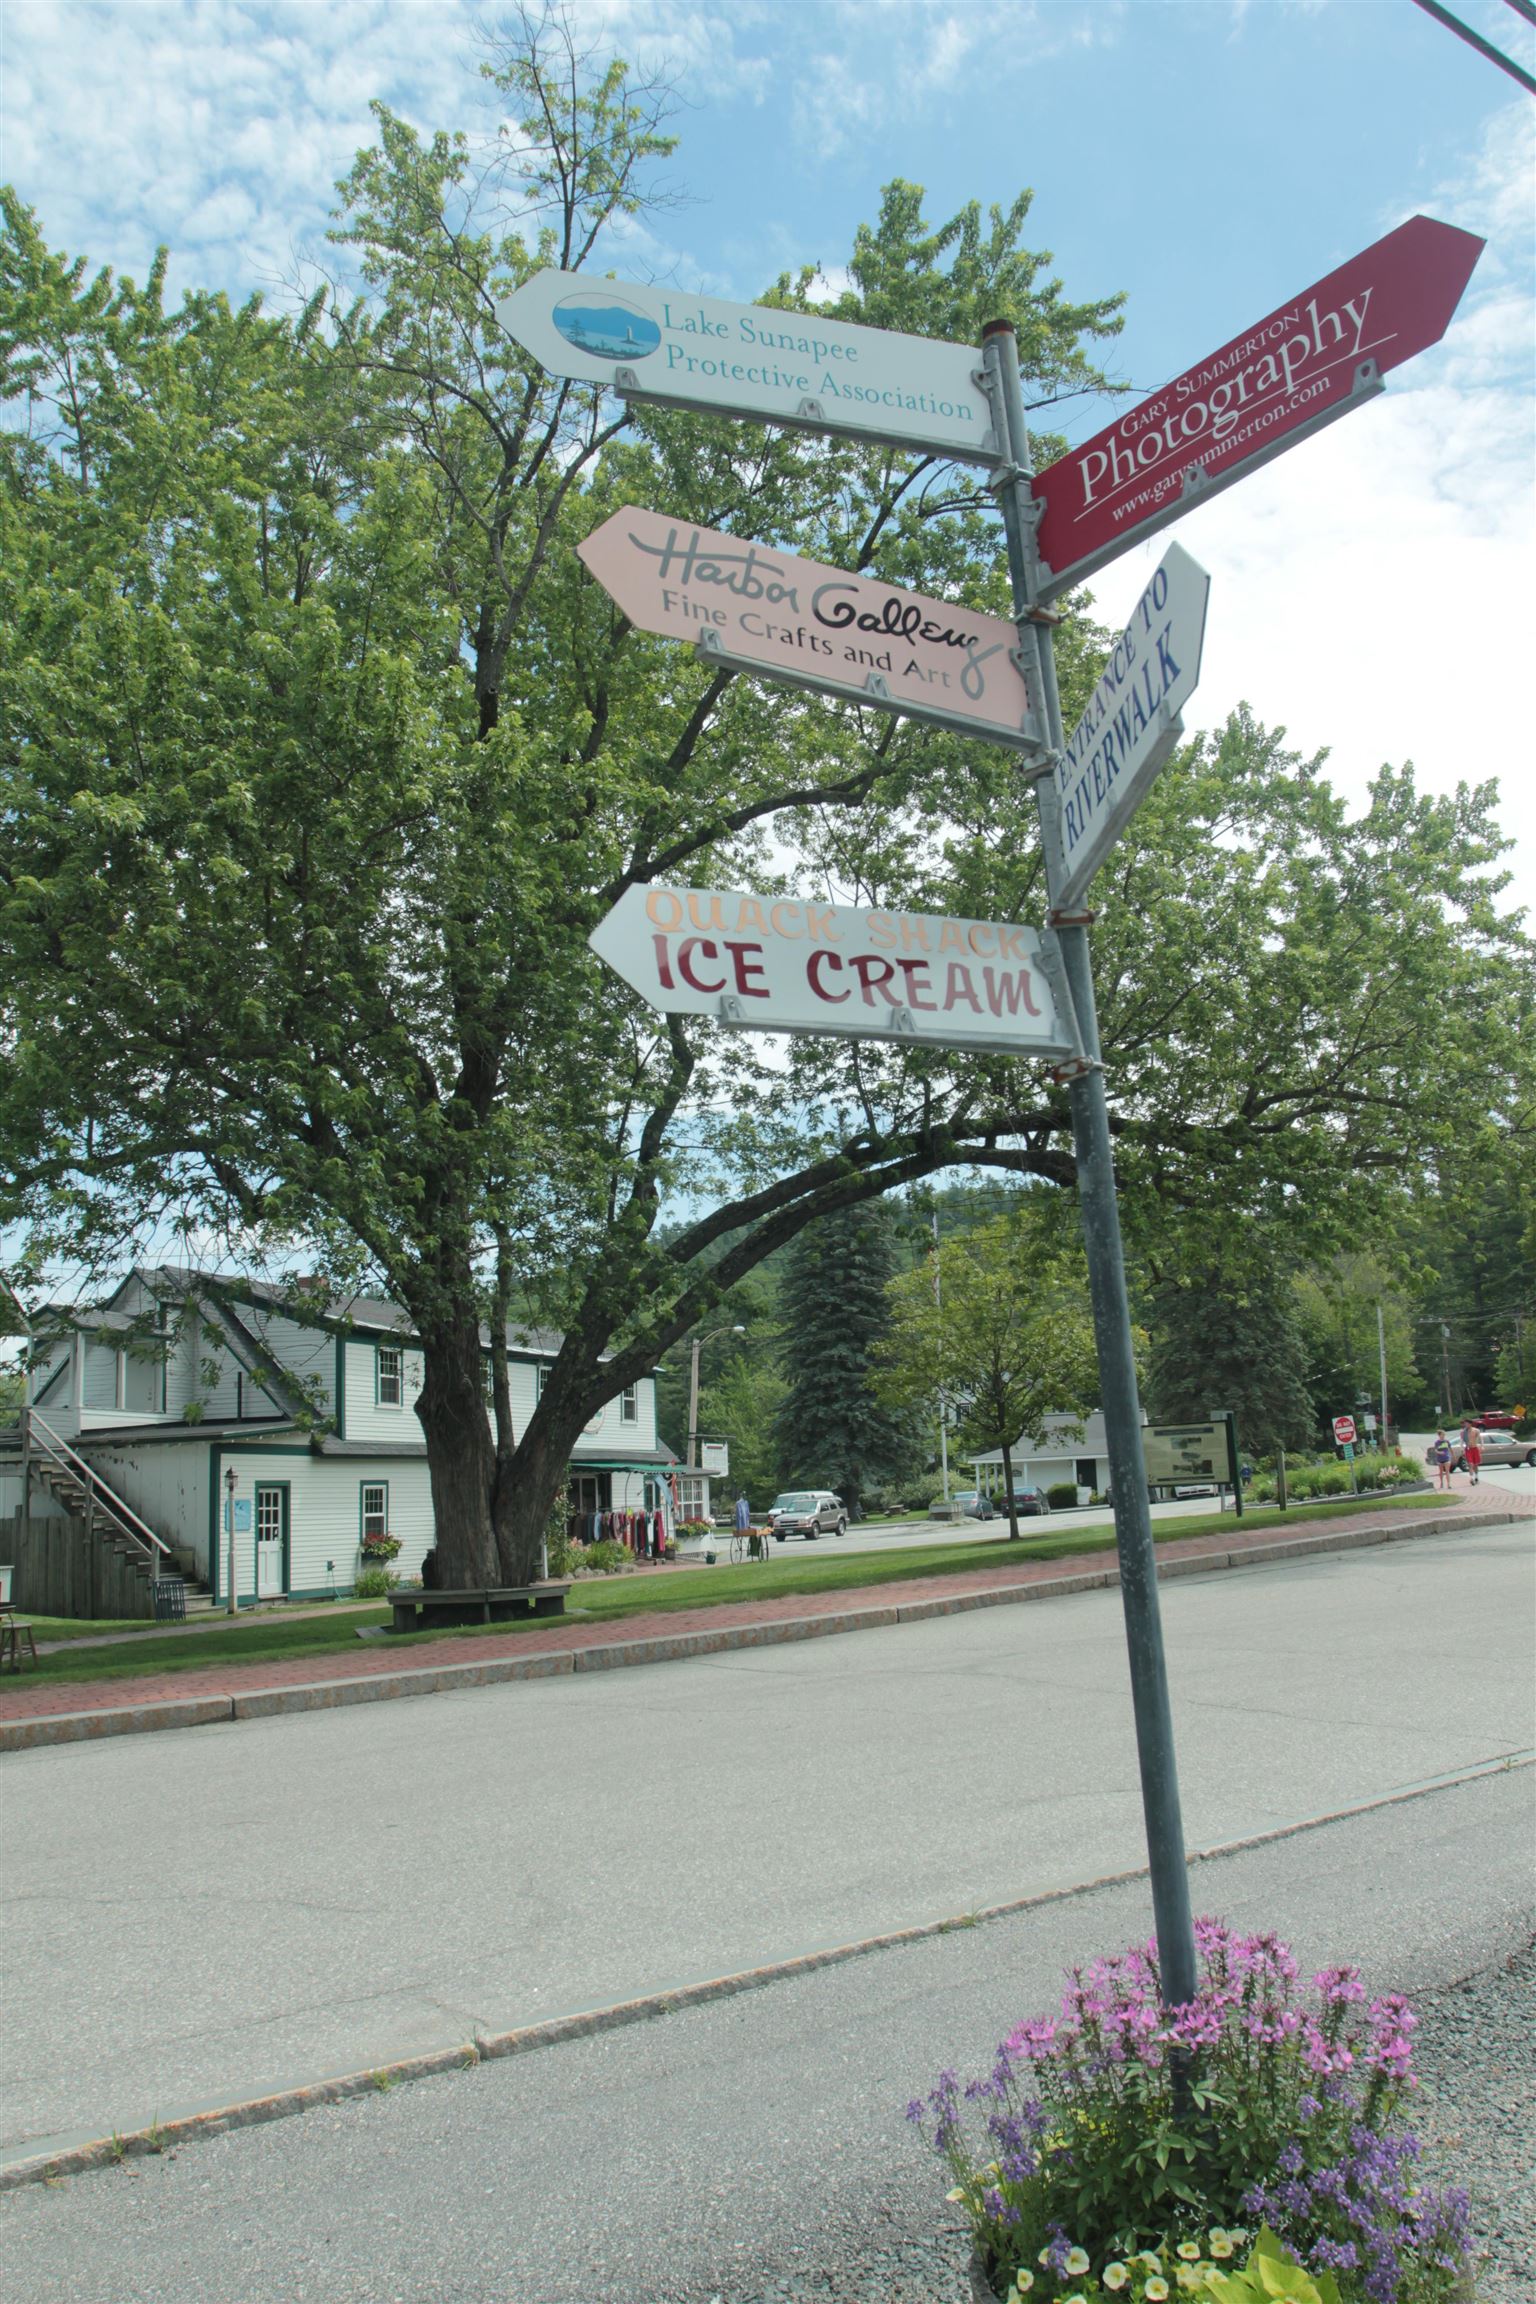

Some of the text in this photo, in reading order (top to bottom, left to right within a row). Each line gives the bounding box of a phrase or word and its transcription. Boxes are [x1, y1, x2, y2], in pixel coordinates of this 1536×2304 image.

[662, 303, 858, 364] Lake Sunapee
[666, 344, 974, 421] Protective Association
[1077, 287, 1374, 506] Photography
[1120, 307, 1301, 438] GARY SUMMERTON
[1112, 374, 1331, 521] www.garysummerton.com
[628, 528, 1004, 700] Harbor Gallery
[662, 590, 951, 688] Fine Crafts and Art
[1059, 567, 1168, 793] ENTRANCE TO
[1064, 620, 1181, 851] RIVERWALK
[645, 890, 1031, 960] QUACK SHACK
[652, 934, 1042, 1017] ICE CREAM
